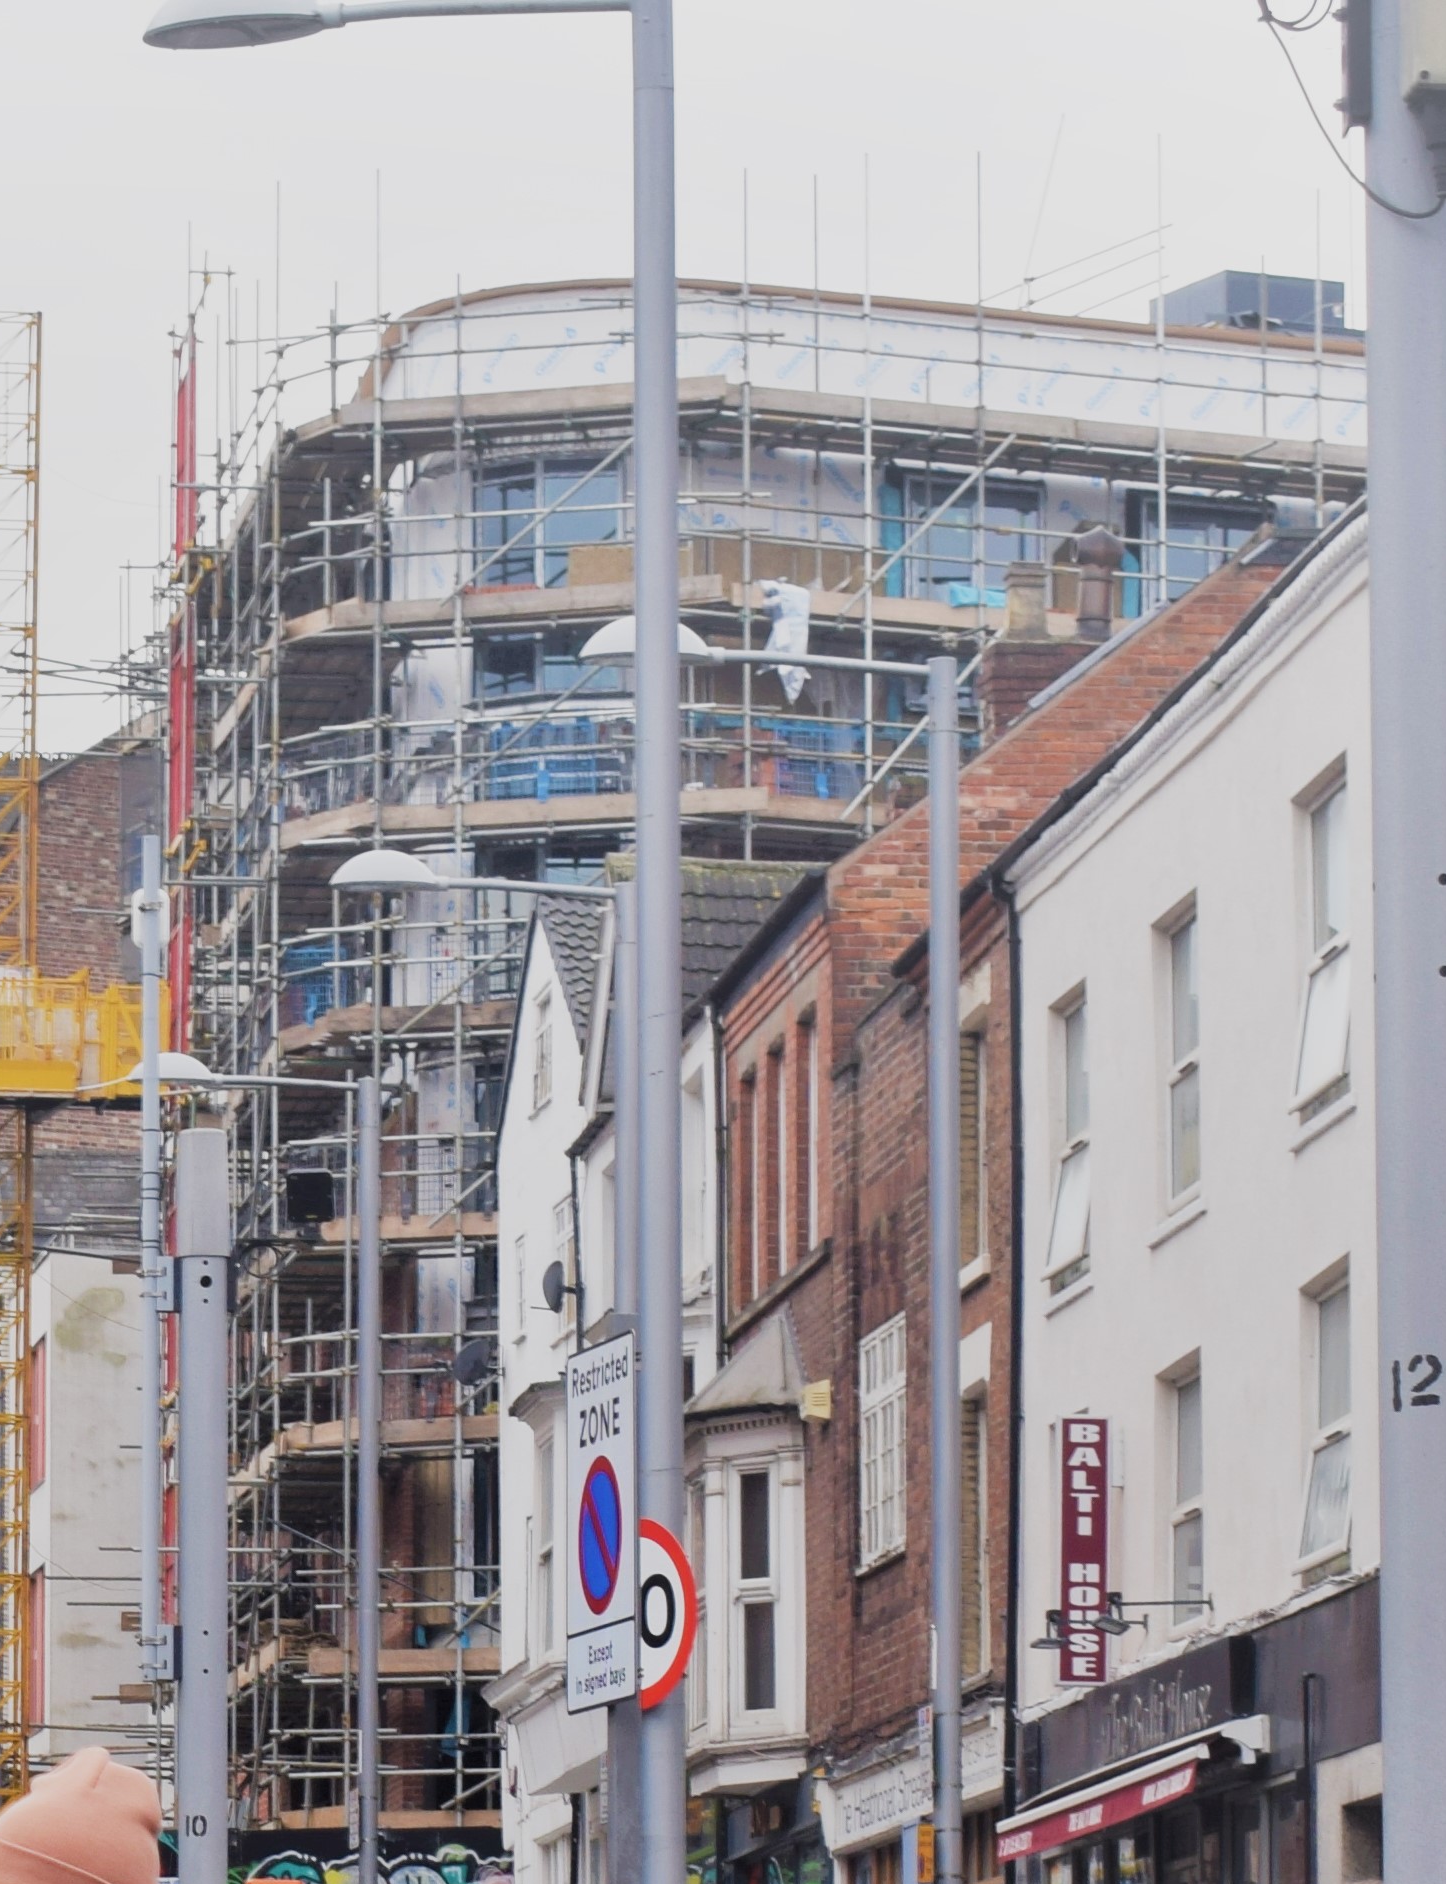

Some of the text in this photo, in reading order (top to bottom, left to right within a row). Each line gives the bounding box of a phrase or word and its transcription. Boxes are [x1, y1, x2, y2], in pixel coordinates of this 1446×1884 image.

[572, 1346, 628, 1398] Restricted
[1392, 1354, 1443, 1413] 12
[579, 1397, 621, 1449] ZONE
[1067, 1423, 1102, 1537] BALTI
[641, 1573, 676, 1649] 0
[1068, 1562, 1101, 1678] HOUSE
[588, 1640, 613, 1665] Except
[584, 1671, 607, 1696] signed
[610, 1667, 626, 1688] bays
[185, 1815, 207, 1837] 10
